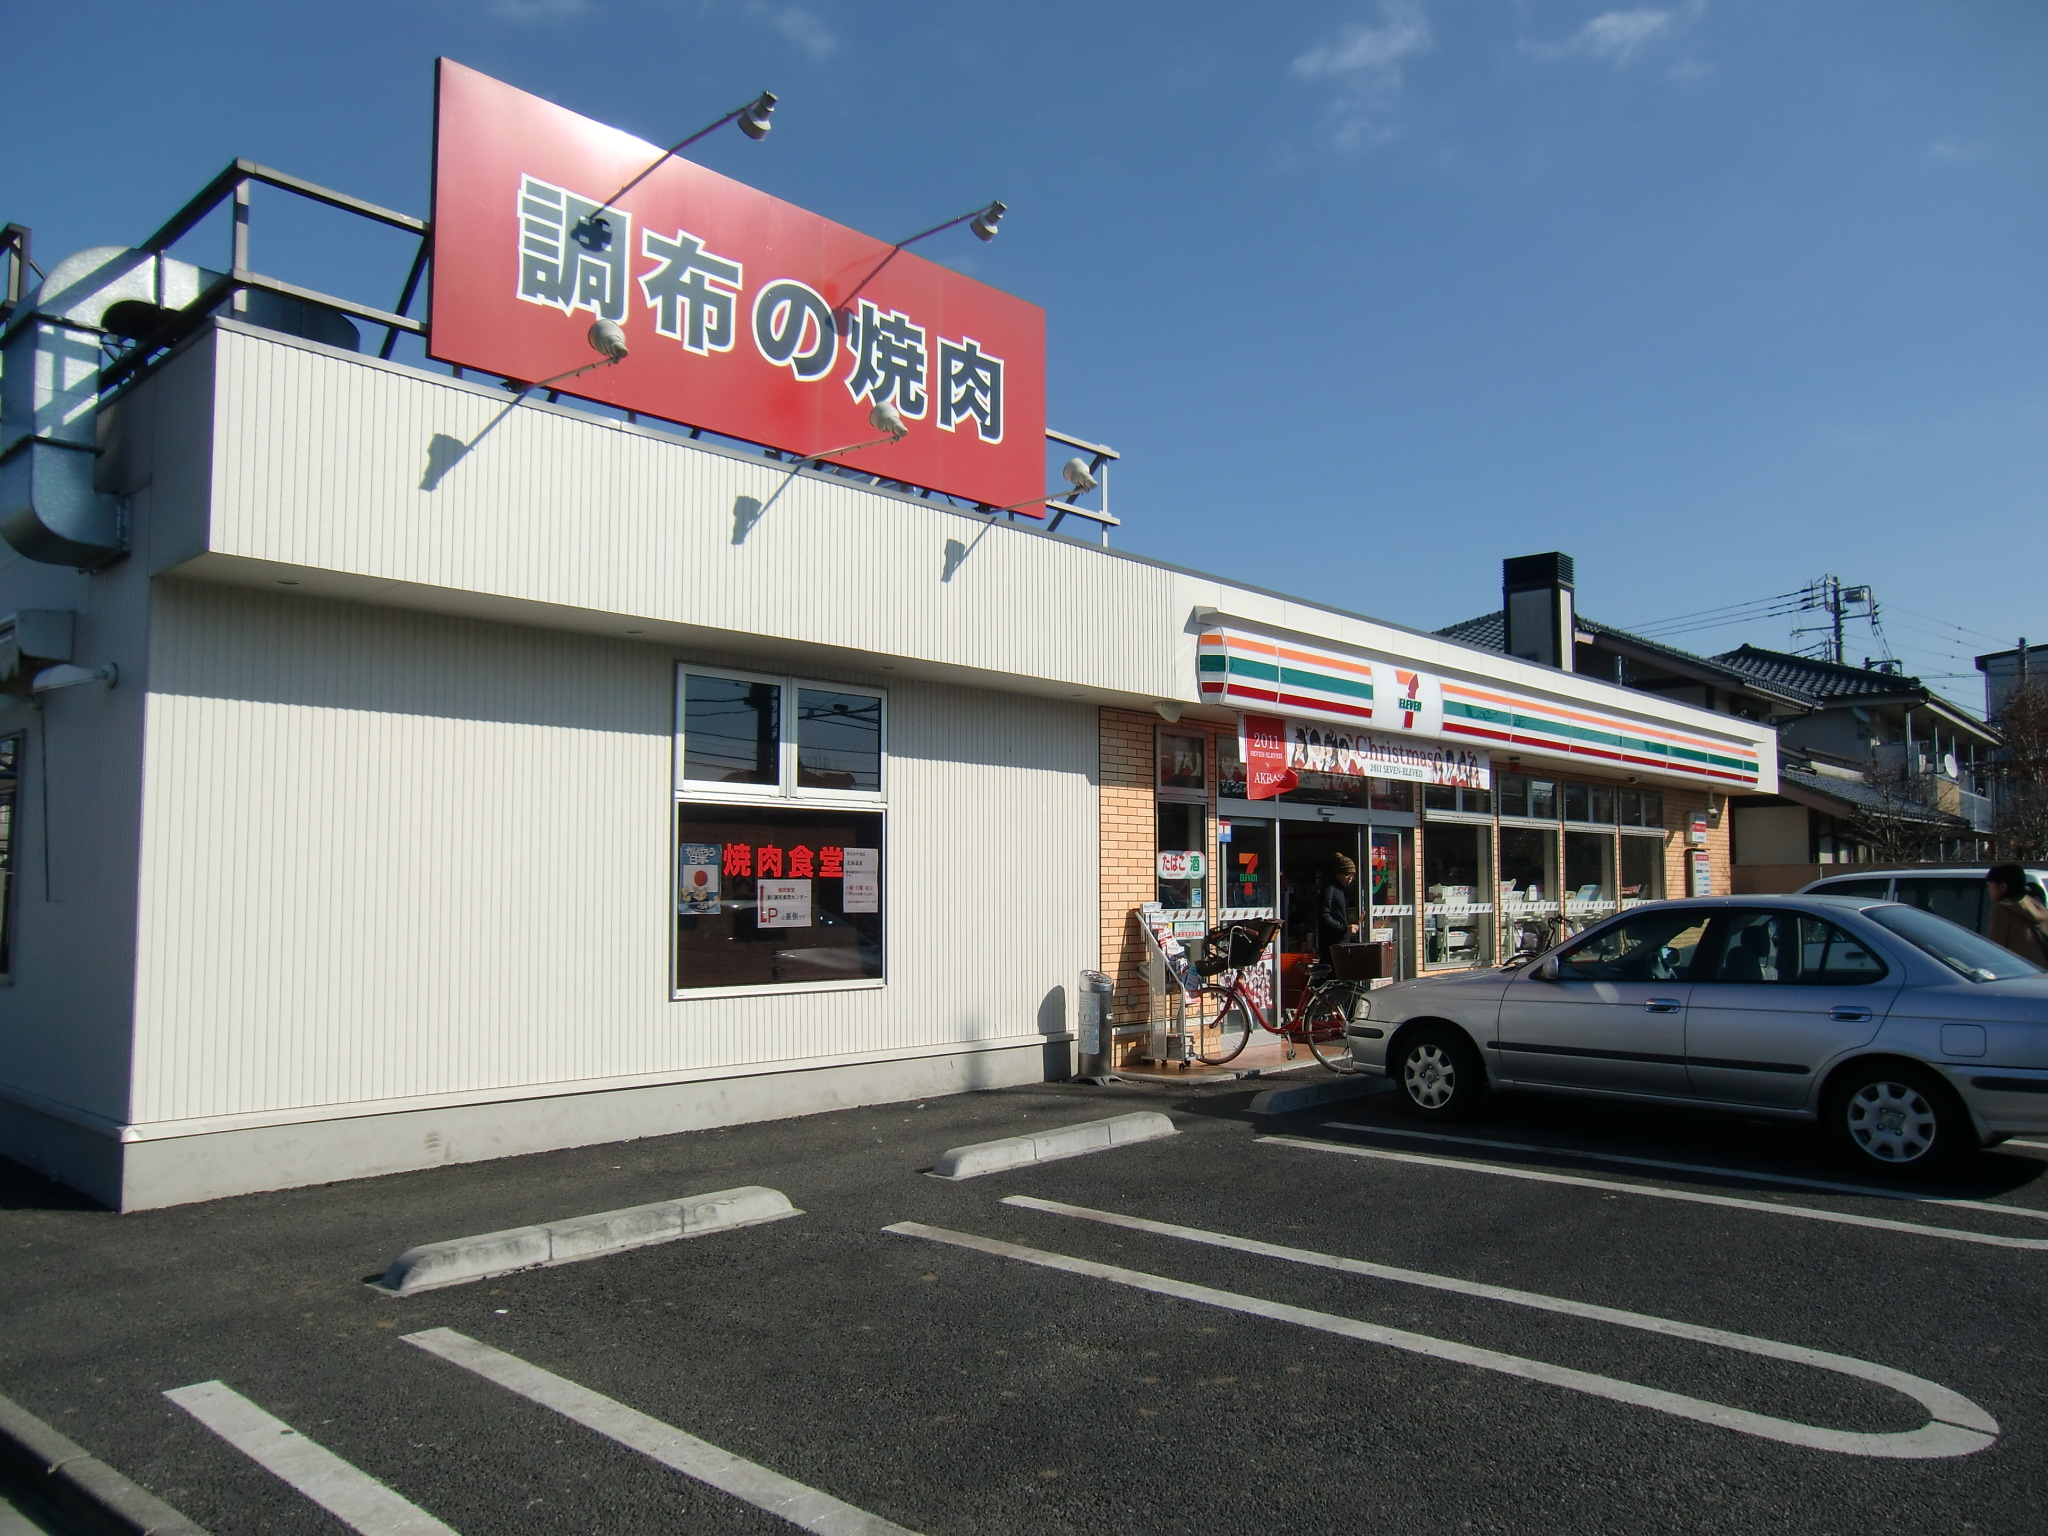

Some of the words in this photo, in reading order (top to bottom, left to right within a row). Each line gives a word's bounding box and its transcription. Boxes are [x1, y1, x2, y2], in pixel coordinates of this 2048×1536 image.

[516, 172, 1004, 445] 調布の焼肉
[1253, 732, 1280, 750] 2011
[1355, 735, 1434, 768] Christmas
[1370, 763, 1382, 774] 2011
[689, 856, 709, 865] 日本
[723, 843, 844, 878] 焼肉食堂
[1162, 855, 1186, 871] たばこ
[1190, 855, 1200, 872] 酒
[1238, 853, 1258, 896] 7
[768, 907, 779, 923] P
